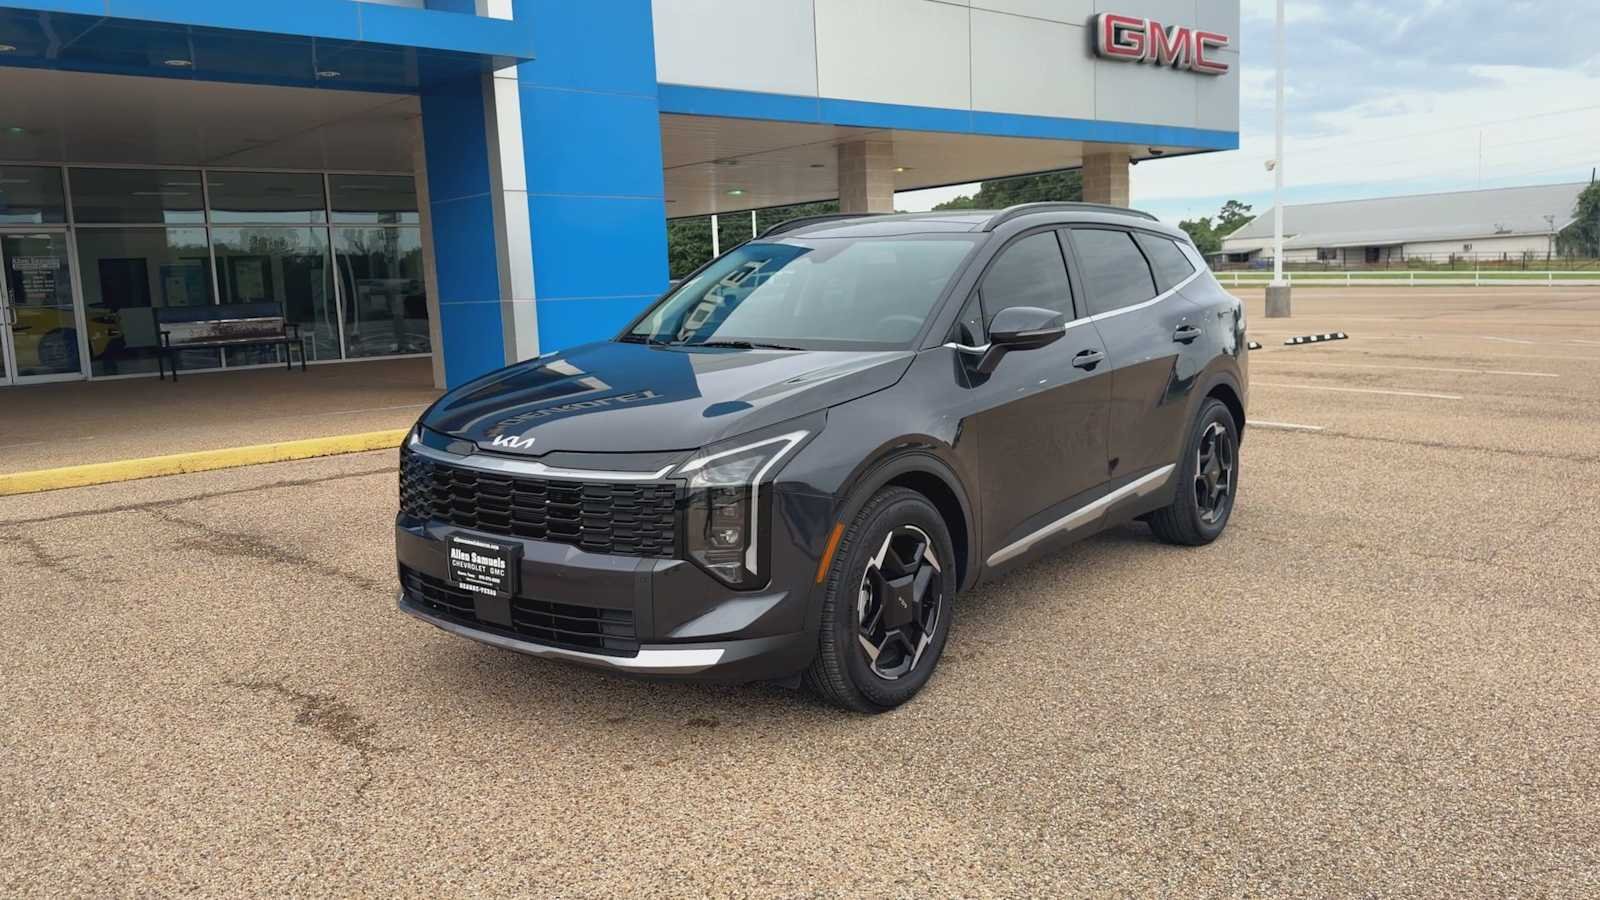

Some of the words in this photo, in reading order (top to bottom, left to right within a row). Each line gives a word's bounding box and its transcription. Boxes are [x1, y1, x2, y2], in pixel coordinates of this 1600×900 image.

[1097, 12, 1230, 75] GMC
[491, 434, 536, 449] KIA
[450, 547, 470, 561] Allen
[471, 552, 506, 569] Samuels
[452, 560, 486, 572] CHEVROLET
[490, 567, 505, 576] GMC
